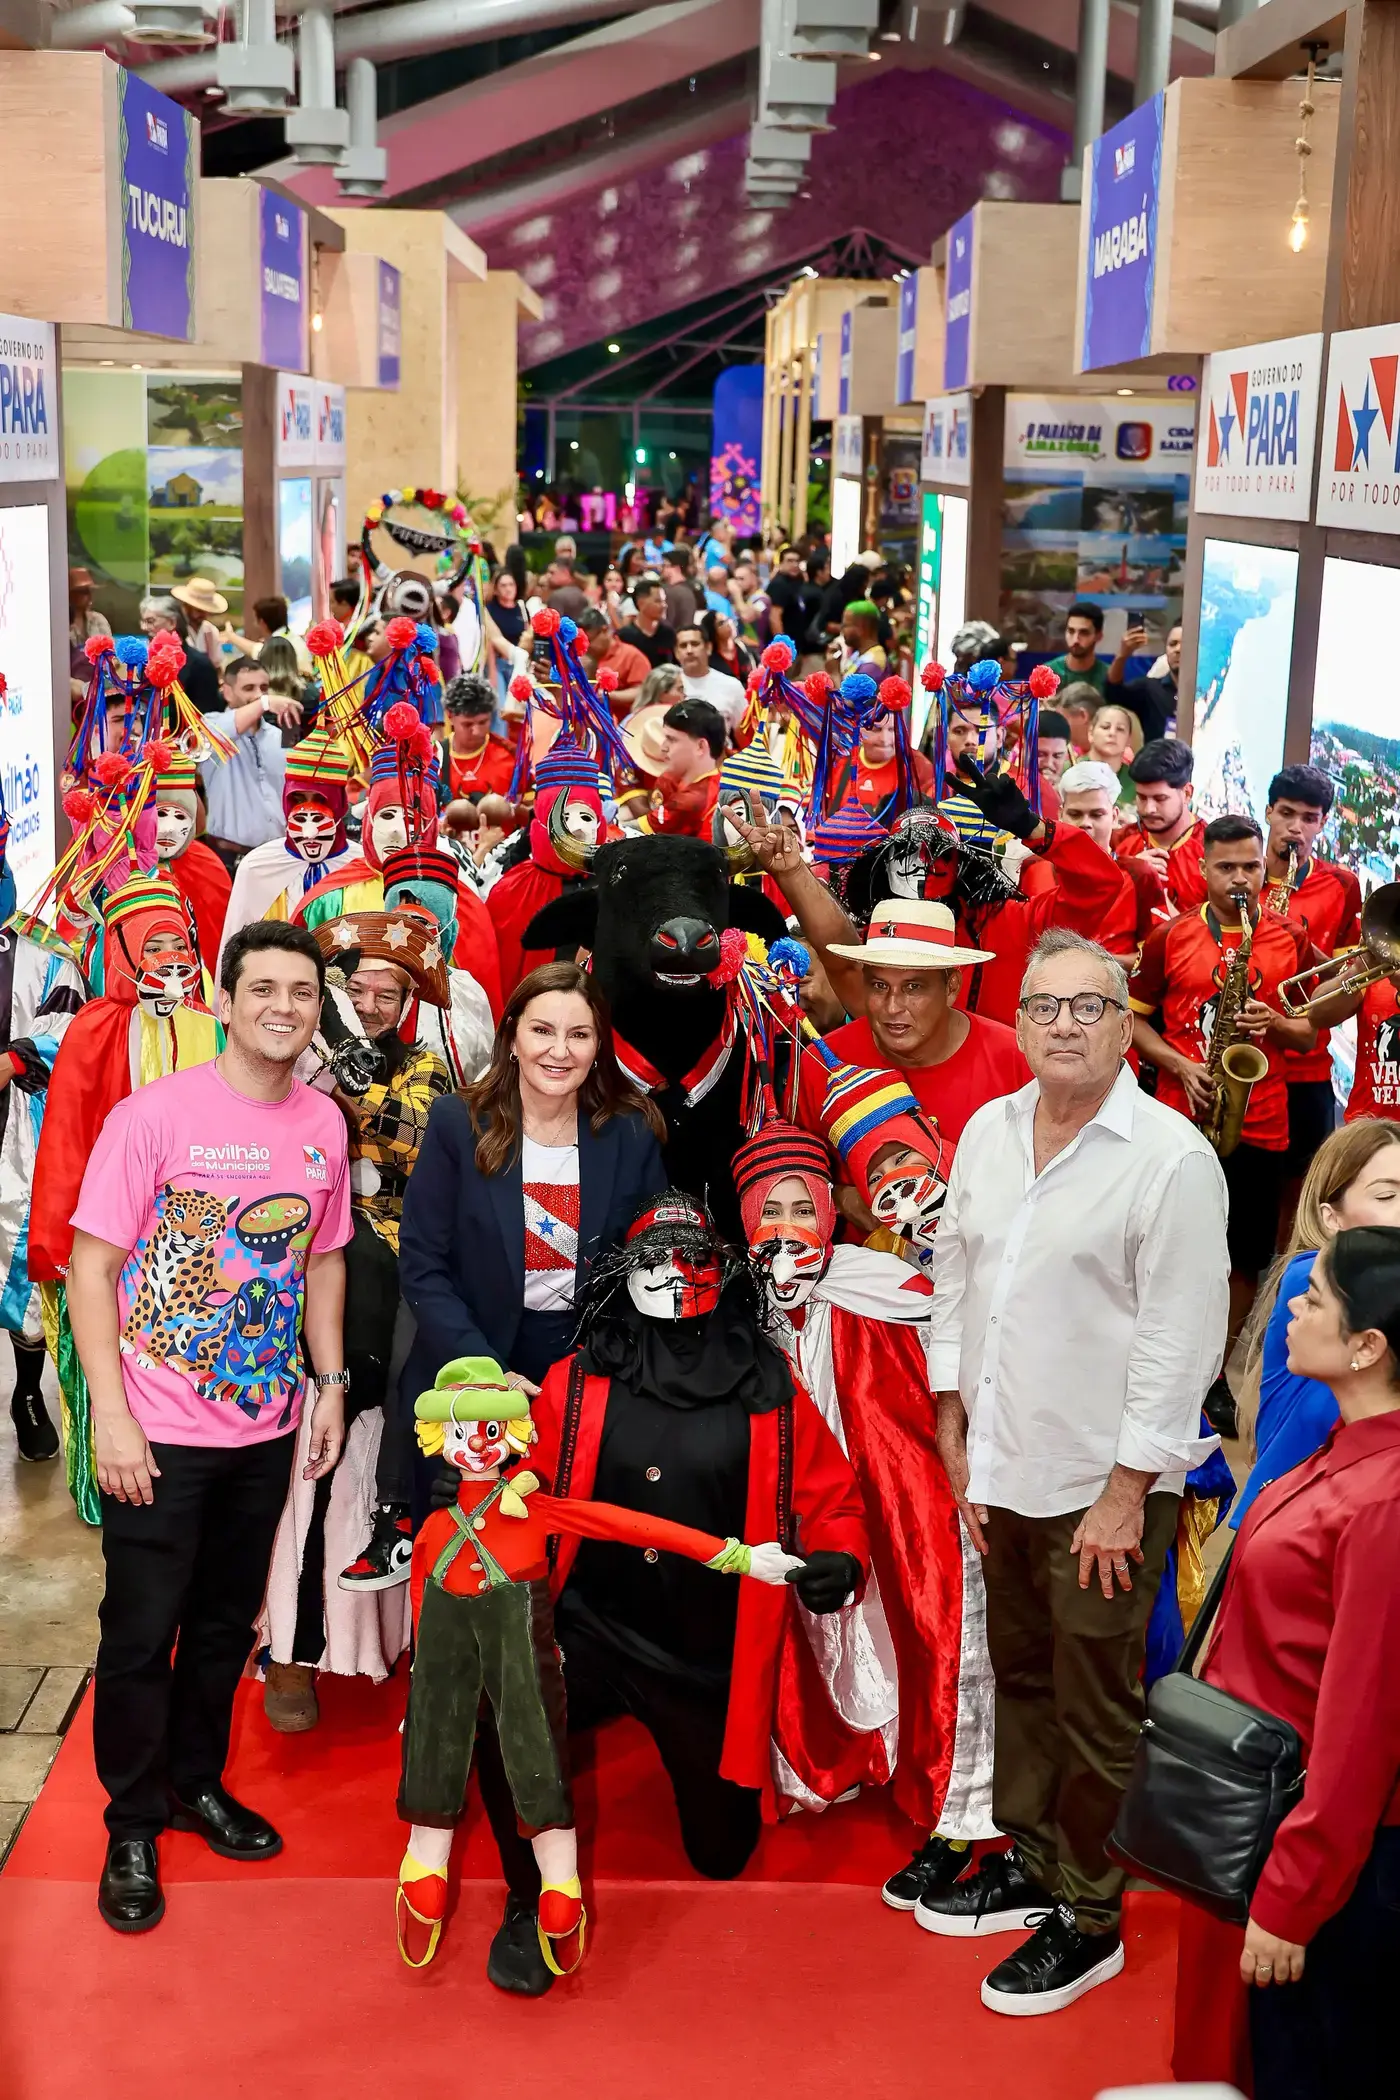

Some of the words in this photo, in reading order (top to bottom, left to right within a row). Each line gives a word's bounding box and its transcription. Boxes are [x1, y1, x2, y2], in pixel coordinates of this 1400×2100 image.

[128, 183, 187, 249] TUCURUÍ
[1093, 192, 1148, 280] MARABÁ
[34, 344, 44, 361] DO
[1251, 364, 1288, 388] GOVERNO
[1291, 362, 1303, 382] DO
[1204, 475, 1221, 493] POR
[1225, 475, 1250, 493] TODO
[1256, 475, 1263, 493] O
[1268, 469, 1296, 494] PARÁ
[1331, 482, 1355, 502] POR
[1363, 483, 1400, 506] TODO
[189, 1142, 270, 1161] Pavilhão
[191, 1160, 205, 1169] dos
[205, 1160, 271, 1174] Municípios
